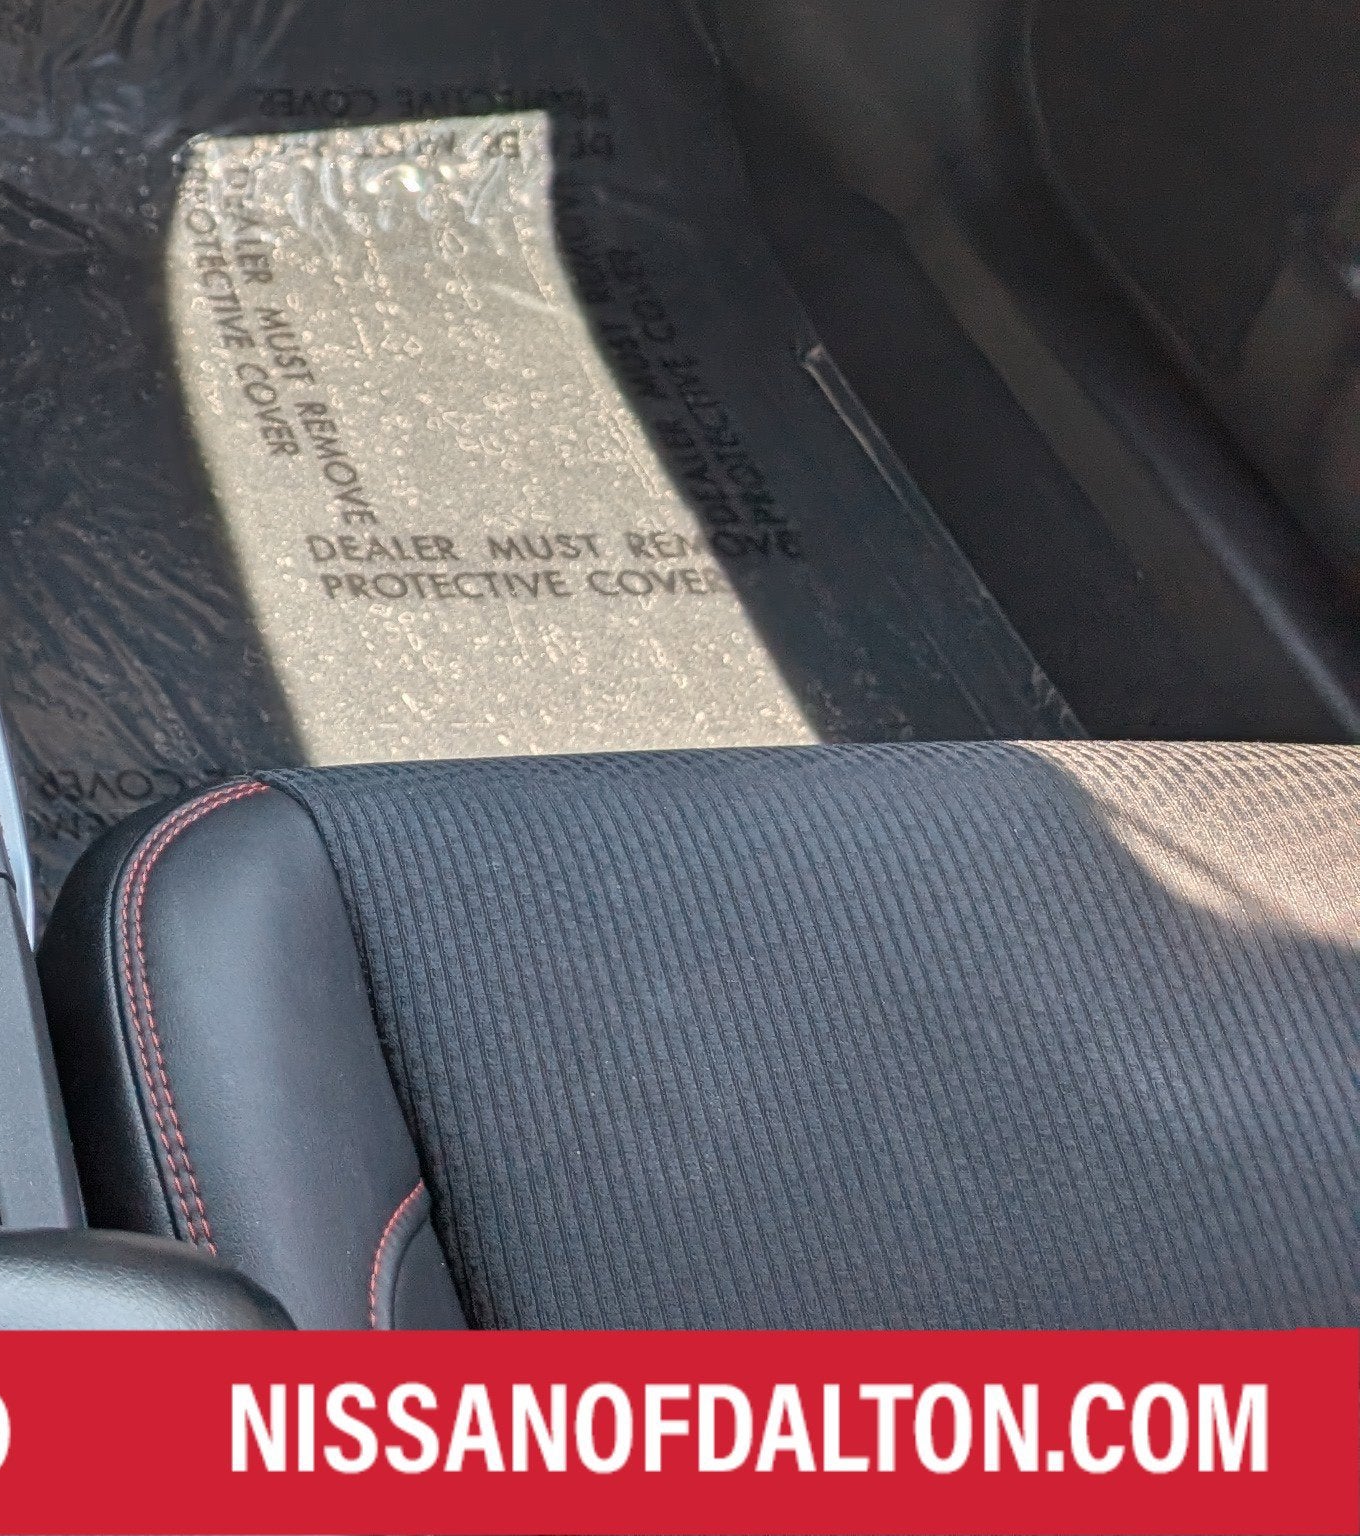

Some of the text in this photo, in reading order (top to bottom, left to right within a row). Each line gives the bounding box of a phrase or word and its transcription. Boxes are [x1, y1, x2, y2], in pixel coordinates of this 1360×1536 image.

[235, 362, 302, 458] COVER
[254, 304, 316, 388] MUST
[293, 398, 379, 526] REMOVE
[305, 532, 460, 564] DEALER
[486, 530, 602, 563] MUST
[318, 567, 728, 601] PROTECTIVE COVER
